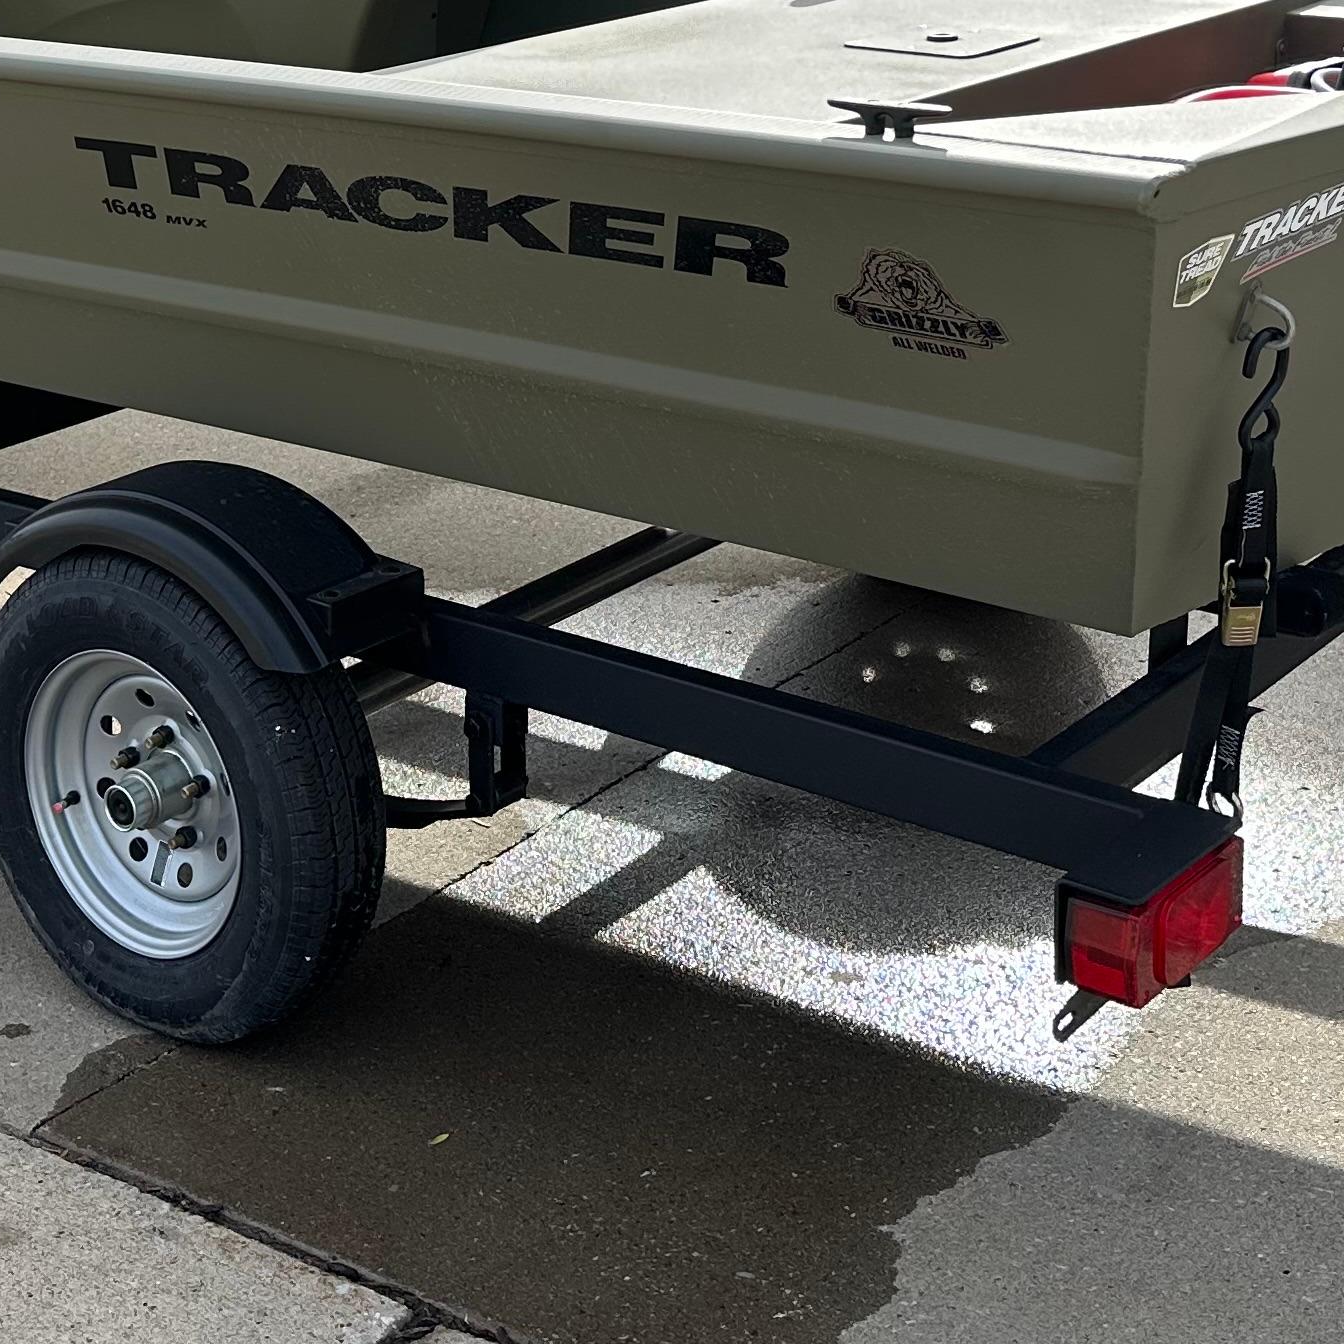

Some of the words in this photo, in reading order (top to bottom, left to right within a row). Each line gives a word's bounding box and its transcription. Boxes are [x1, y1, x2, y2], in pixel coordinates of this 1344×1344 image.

[74, 136, 790, 288] TRACKER
[102, 197, 156, 220] 1648
[166, 215, 207, 229] MVX
[1186, 241, 1225, 269] SURE
[1180, 256, 1222, 284] TREAD
[871, 309, 968, 338] GRIZZLY
[892, 336, 913, 350] ALL
[915, 340, 967, 359] WELDED
